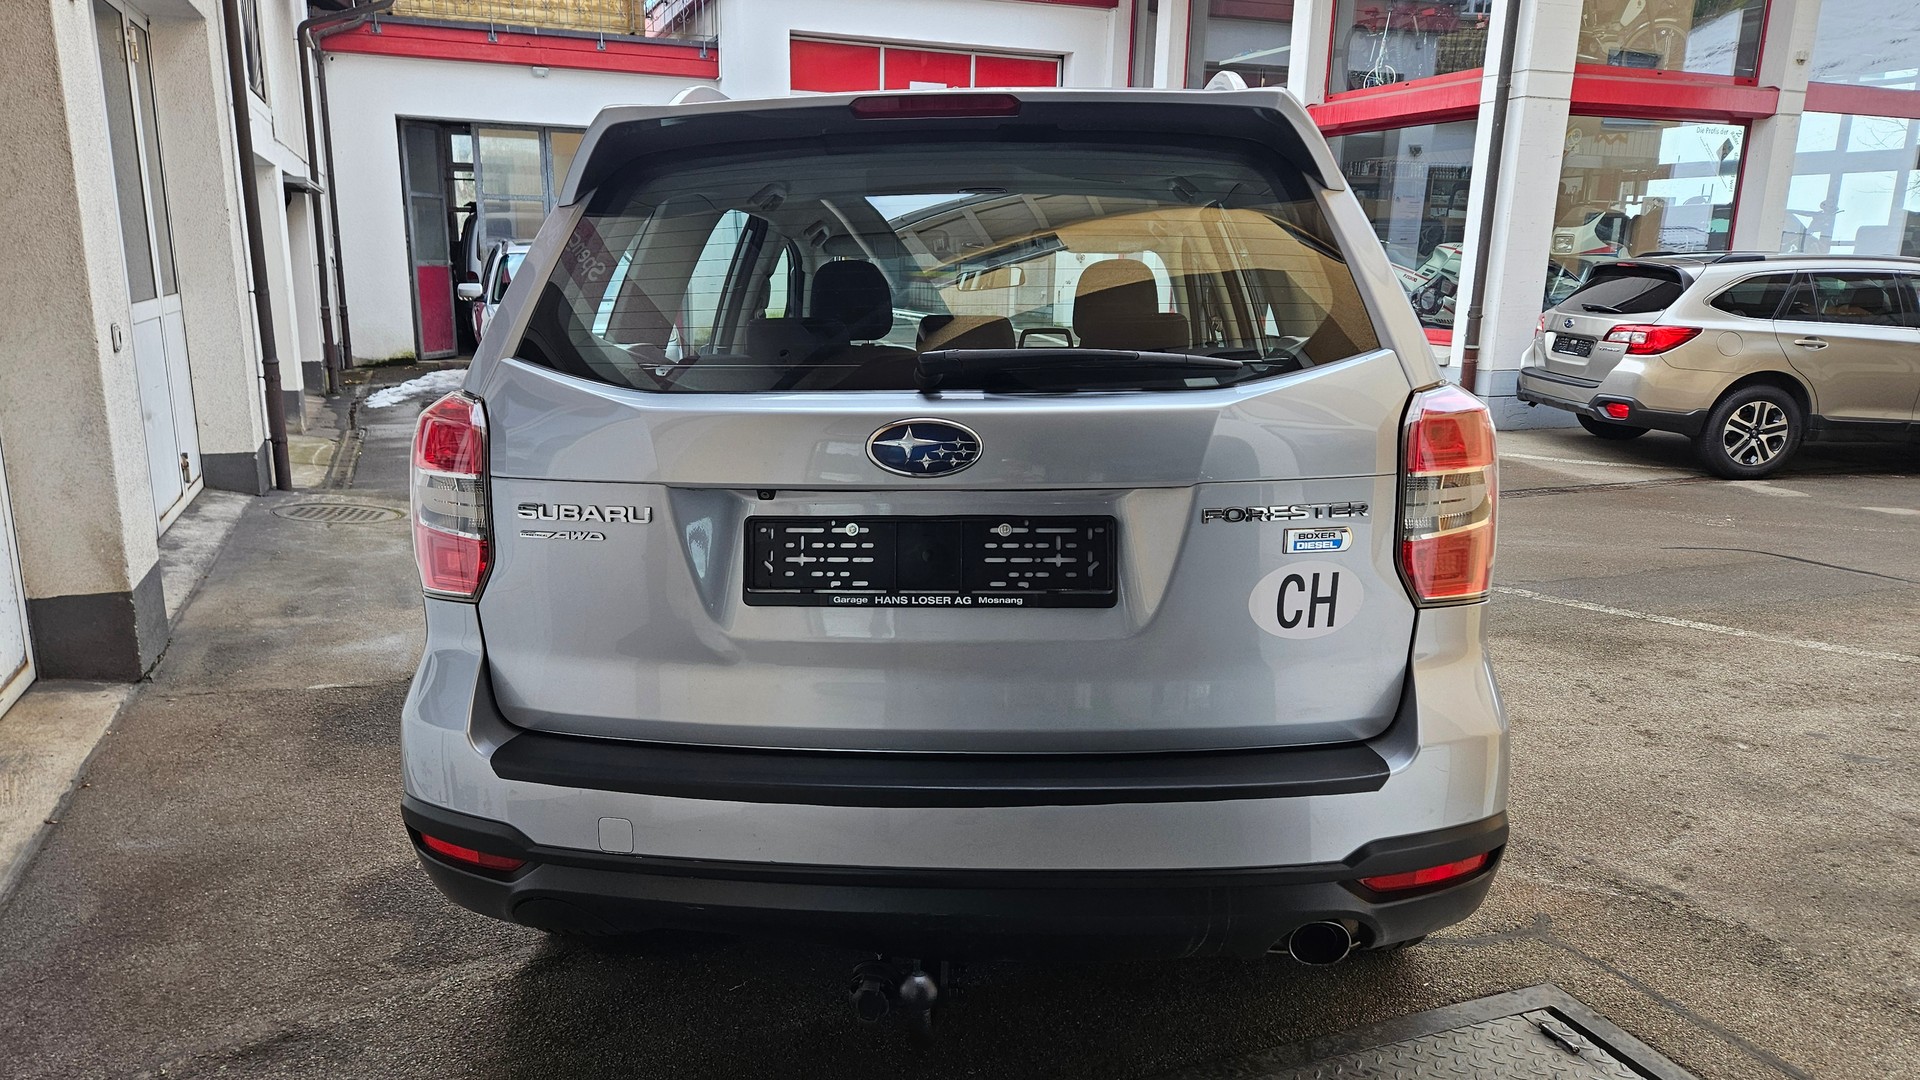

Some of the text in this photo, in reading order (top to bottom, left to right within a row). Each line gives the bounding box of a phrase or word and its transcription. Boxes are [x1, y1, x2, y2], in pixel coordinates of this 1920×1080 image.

[1696, 126, 1705, 135] Die
[1705, 126, 1720, 135] Profis
[1719, 127, 1729, 136] der
[517, 502, 652, 524] SUBARU
[1202, 501, 1369, 525] FORESTER
[548, 531, 606, 541] AWD
[1298, 532, 1336, 541] BOXER
[1296, 540, 1339, 550] DIESEL
[833, 595, 1023, 606] Garage HANS LOSER AG Mosnang
[1276, 571, 1340, 629] CH
